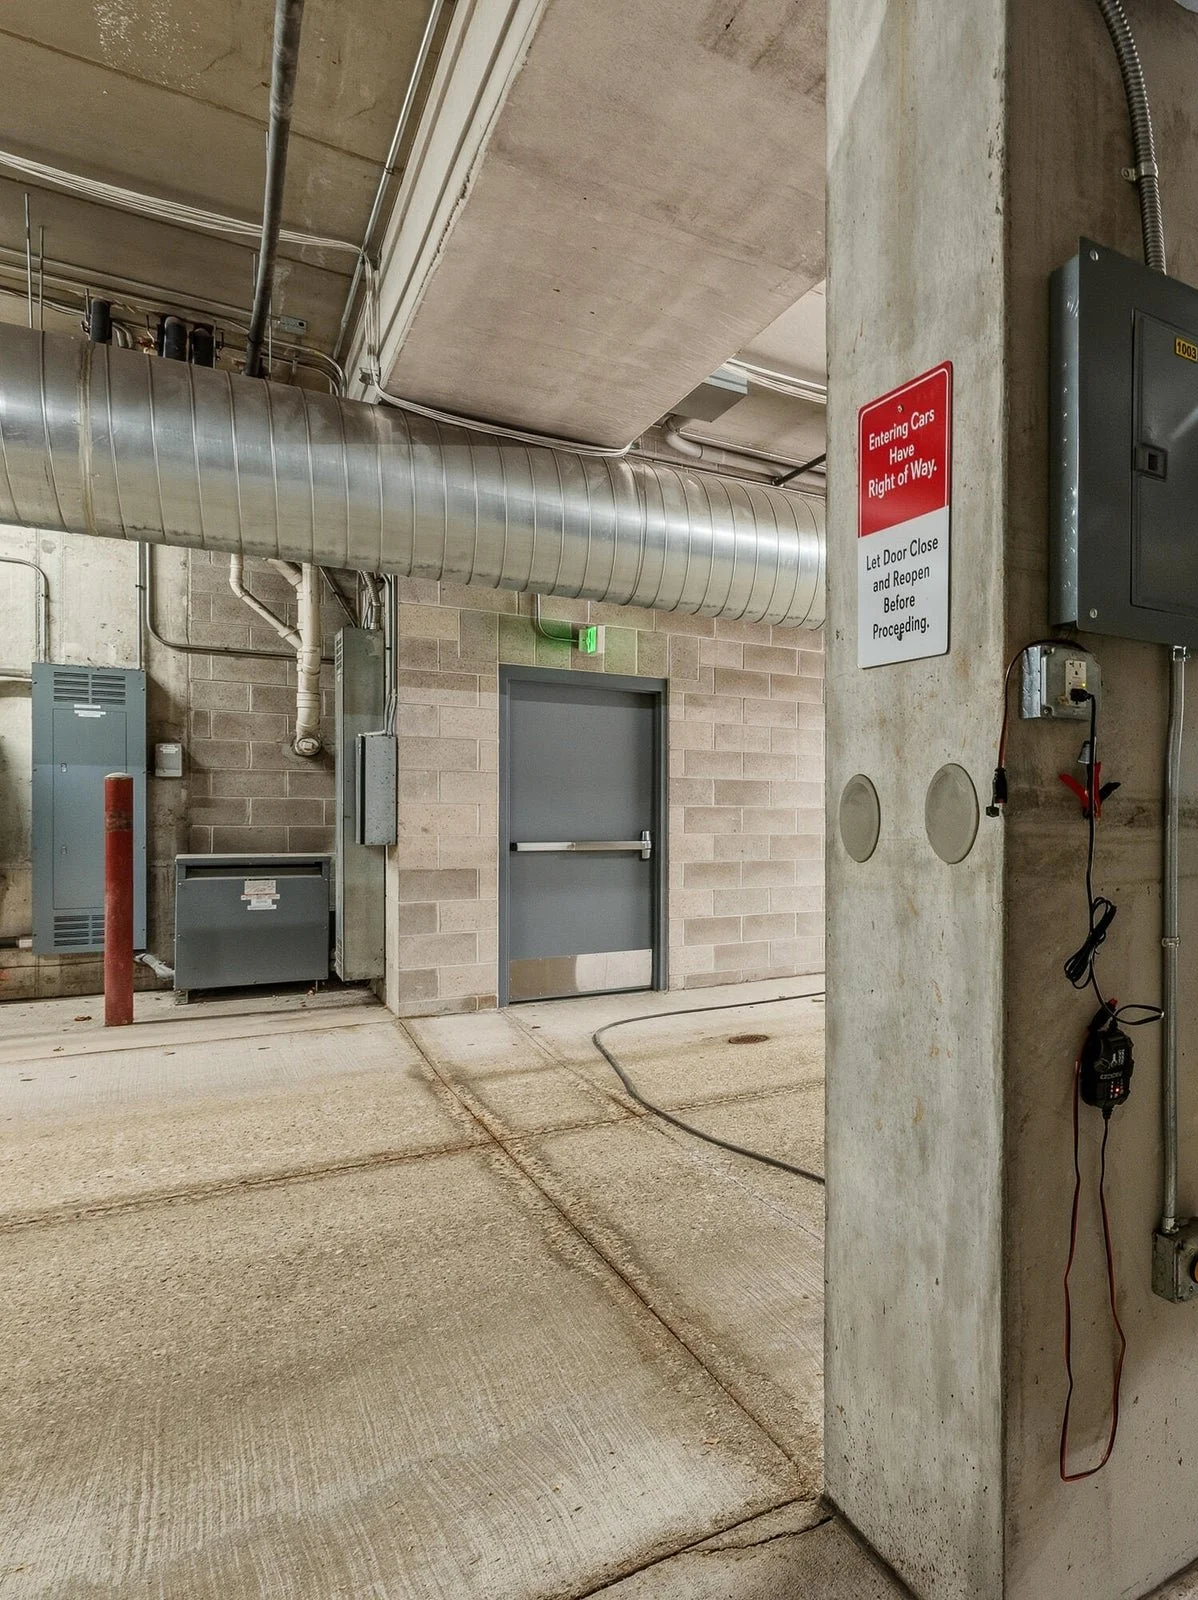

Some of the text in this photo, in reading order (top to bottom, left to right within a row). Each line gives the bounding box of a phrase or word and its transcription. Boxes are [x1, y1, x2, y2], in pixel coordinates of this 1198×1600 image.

[1177, 341, 1197, 360] 1003
[869, 409, 935, 451] Entering Cars
[889, 444, 915, 465] Have
[868, 457, 938, 499] Right of Way.
[866, 537, 939, 571] Let Door Close
[873, 566, 930, 592] and Reopen
[884, 594, 916, 613] Before
[873, 616, 930, 640] Proceeding.
